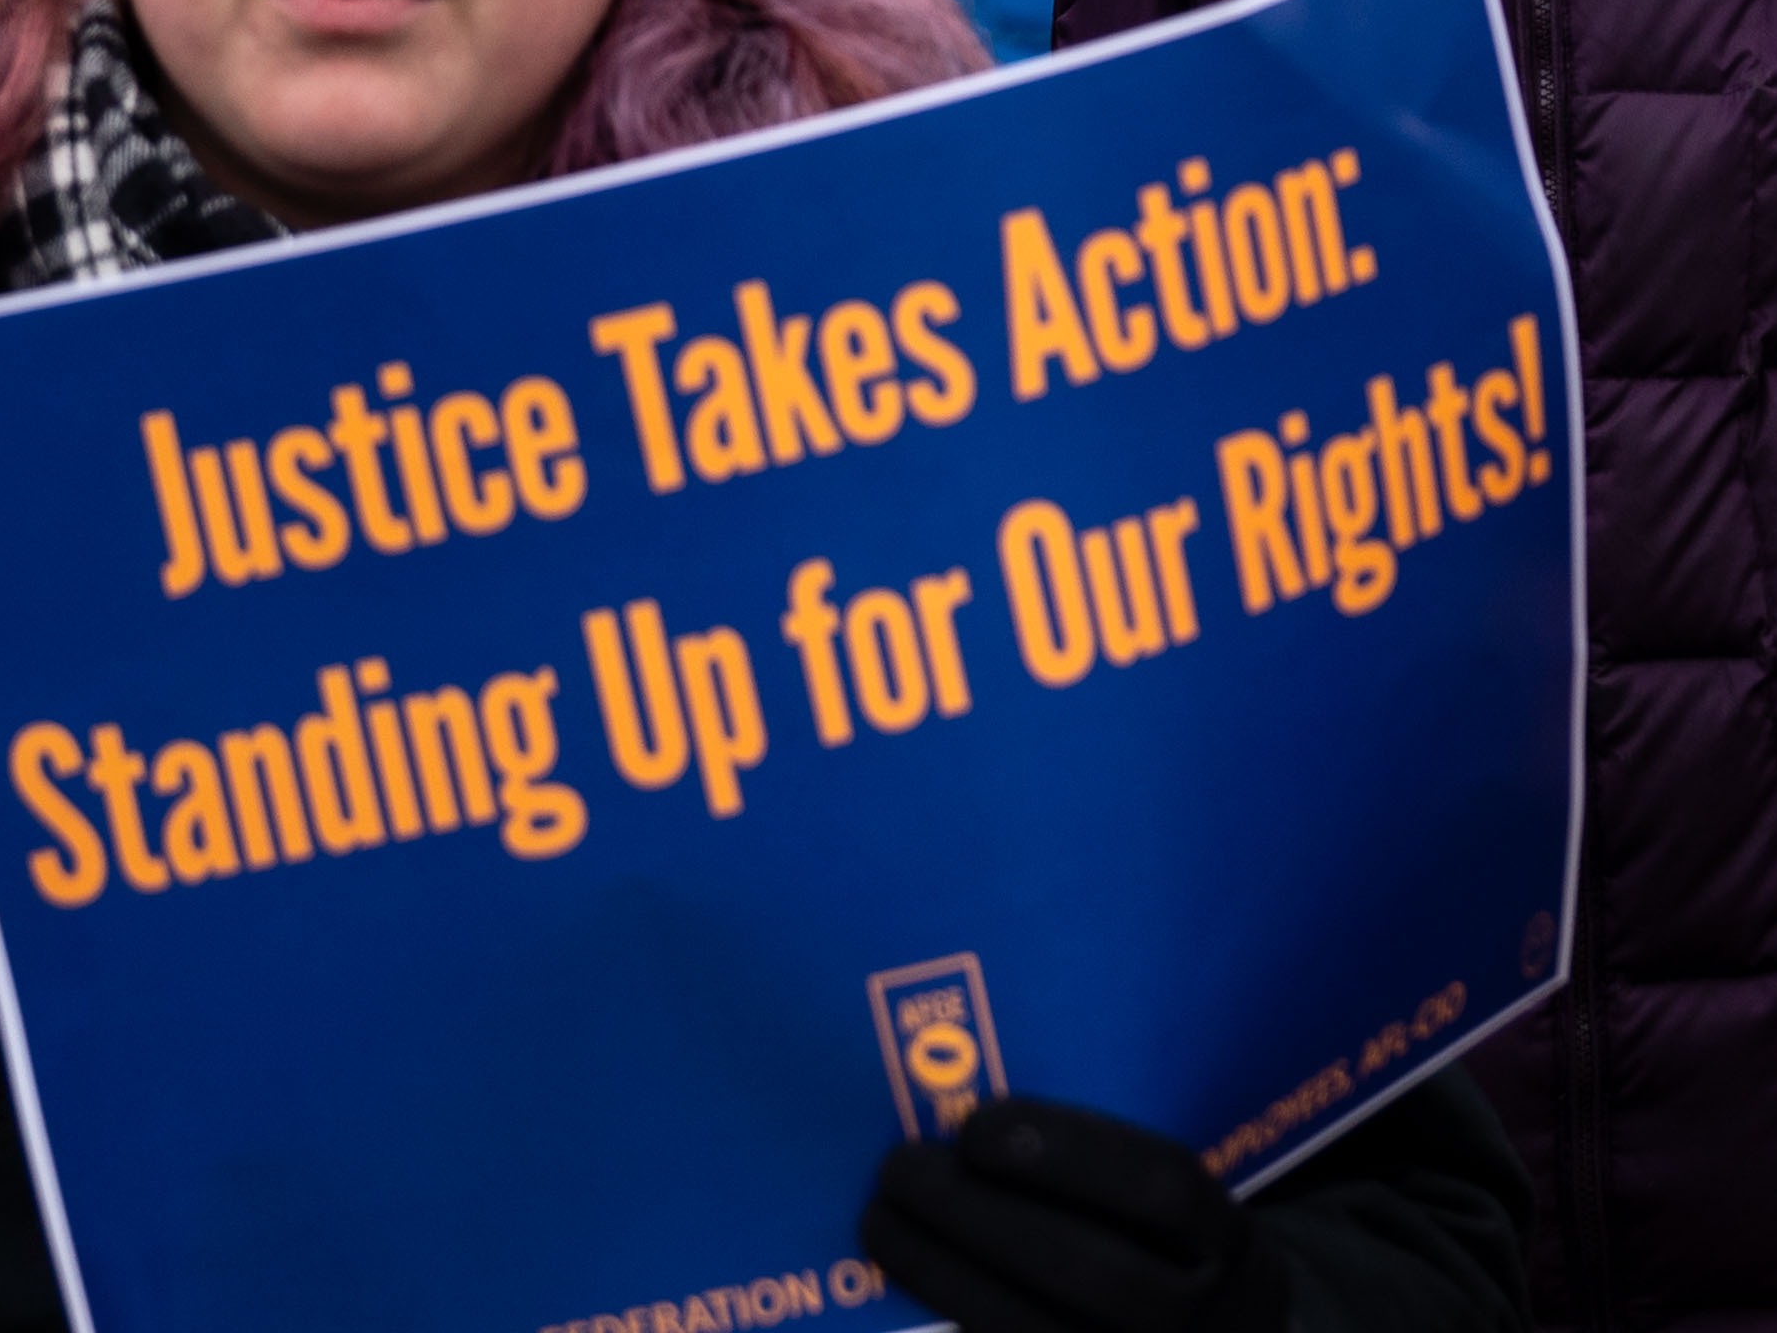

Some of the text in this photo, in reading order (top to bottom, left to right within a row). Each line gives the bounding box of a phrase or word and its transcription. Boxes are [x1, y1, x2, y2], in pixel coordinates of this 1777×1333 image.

[12, 315, 1551, 904] Standing Up for Our Rights!
[144, 152, 1374, 594] Justice Takes Action:
